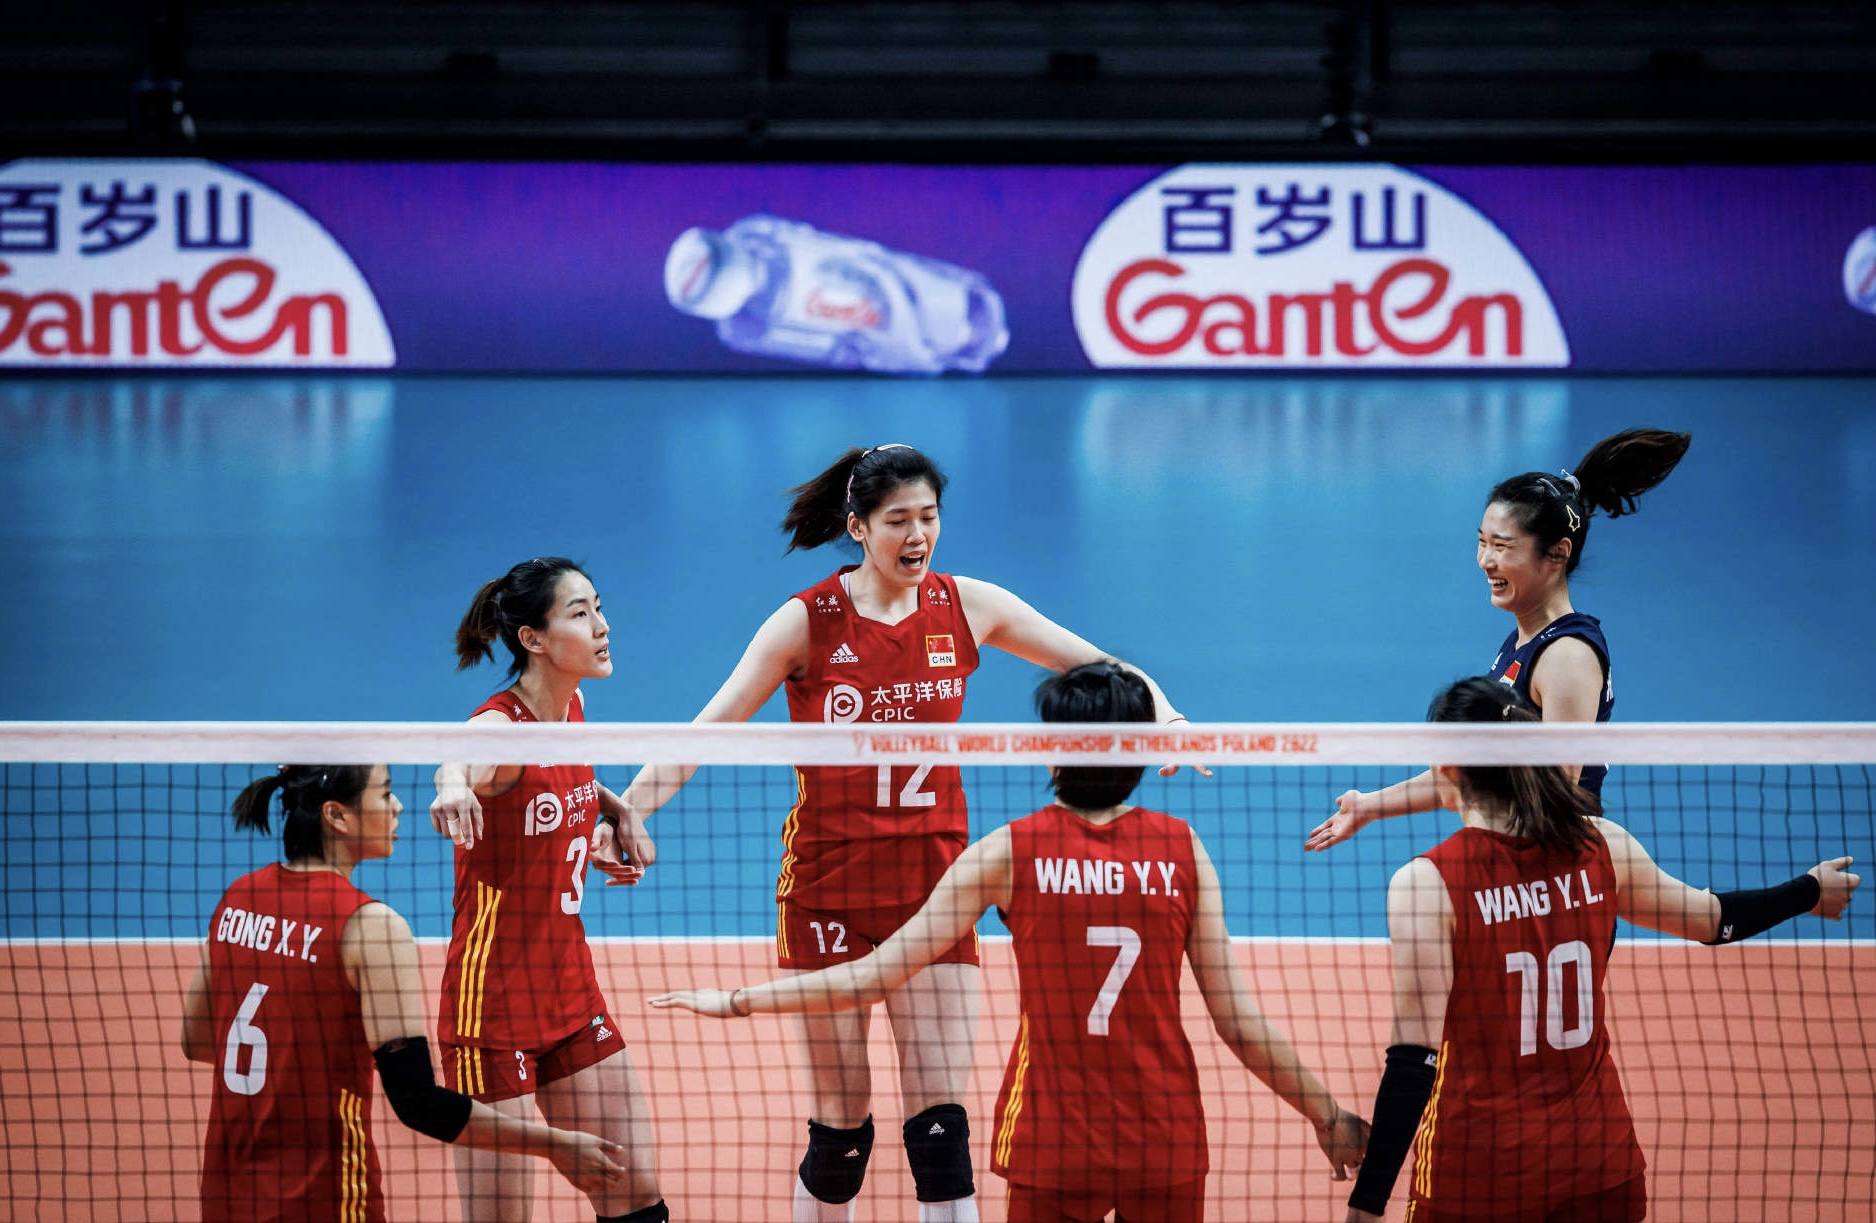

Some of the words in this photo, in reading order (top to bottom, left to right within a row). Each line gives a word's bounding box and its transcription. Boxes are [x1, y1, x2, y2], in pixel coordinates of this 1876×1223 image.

[0, 181, 253, 256] 百岁山
[1159, 183, 1427, 256] 百岁山
[0, 257, 348, 357] anten
[1105, 258, 1523, 358] Ganten
[829, 654, 859, 664] adidas
[932, 655, 952, 664] CHN
[871, 706, 915, 722] CPIC
[870, 734, 949, 752] VOLLEYBALL
[957, 734, 1006, 752] WORLD
[1120, 734, 1217, 752] NETHERLANDS
[1222, 734, 1276, 752] POLAND
[567, 809, 586, 828] CPIC
[561, 836, 587, 915] 3
[1034, 857, 1124, 895] WANG
[1474, 880, 1551, 925] WANG
[216, 907, 276, 951] GONG
[809, 921, 848, 954] 12
[1086, 926, 1142, 1036] 7
[1505, 940, 1594, 1056] 10
[223, 982, 269, 1096] 6
